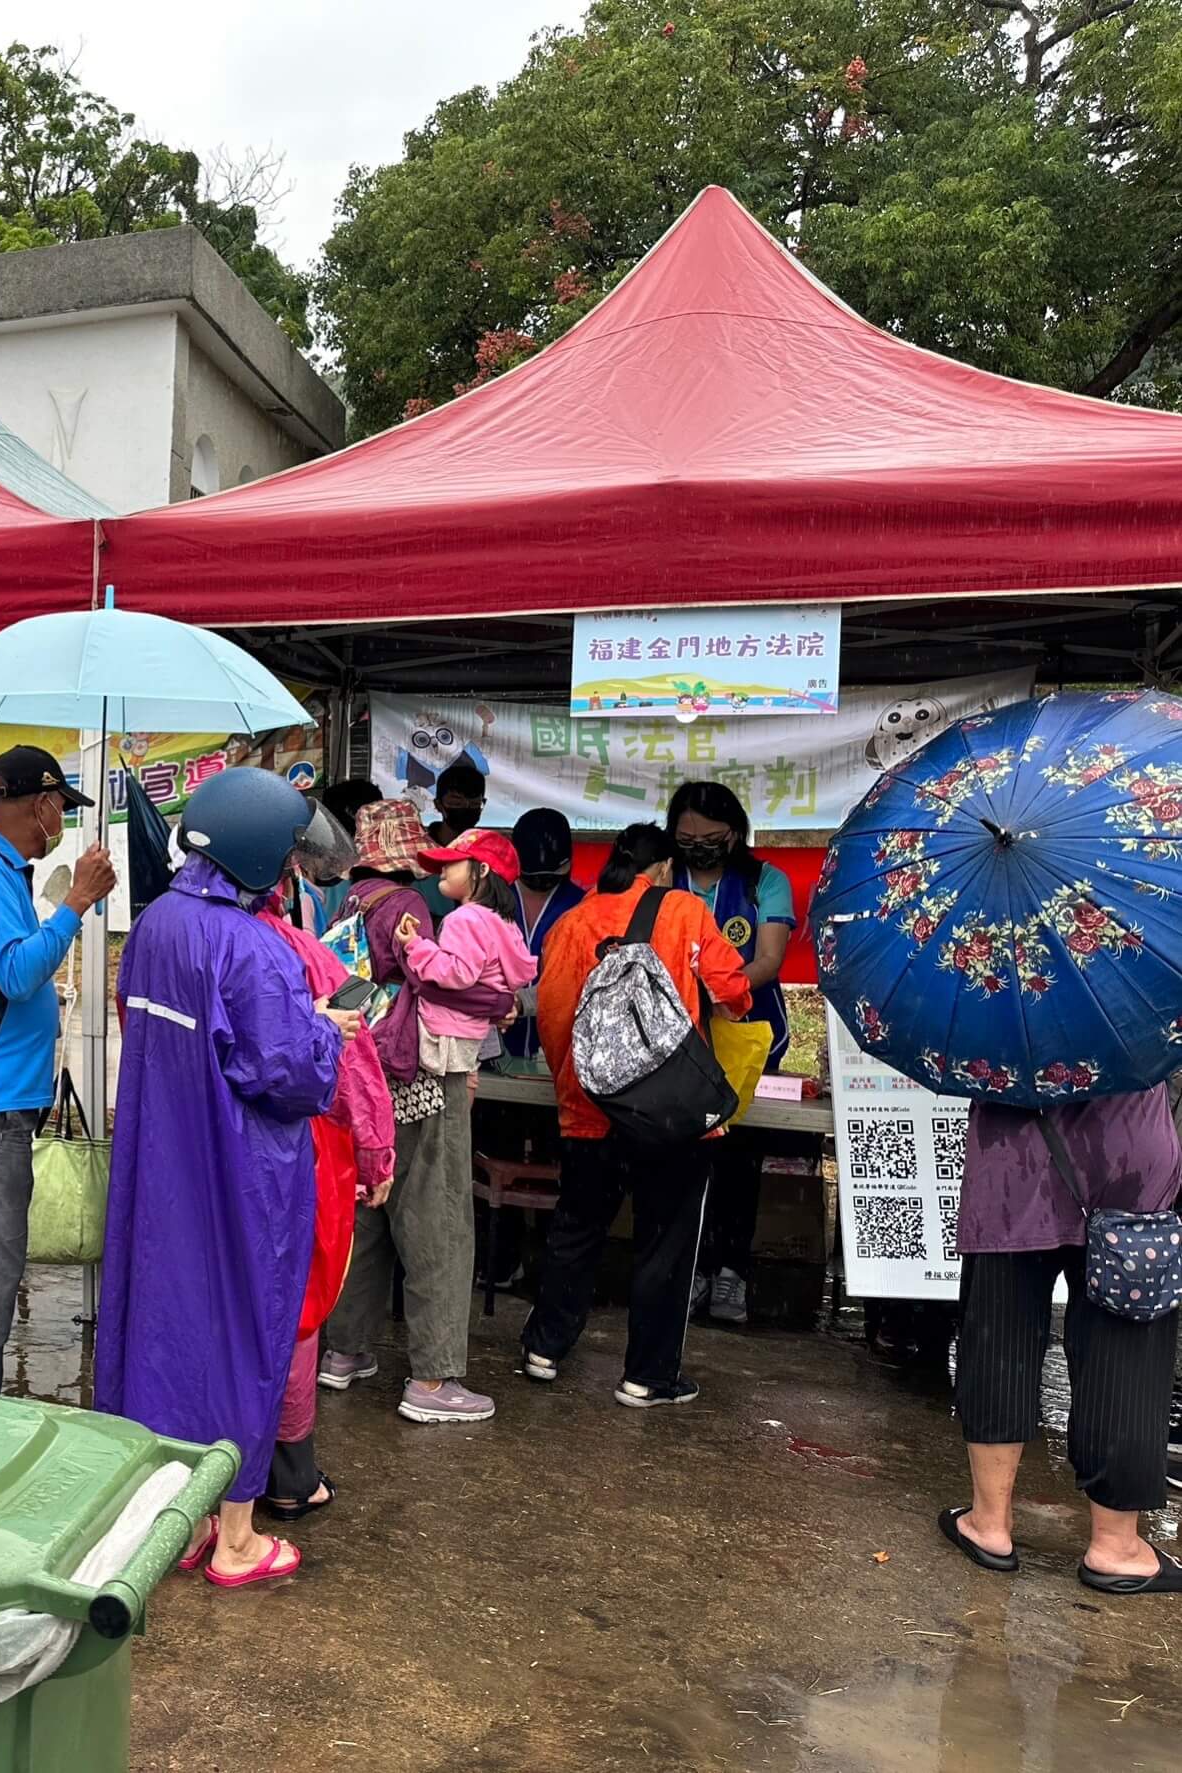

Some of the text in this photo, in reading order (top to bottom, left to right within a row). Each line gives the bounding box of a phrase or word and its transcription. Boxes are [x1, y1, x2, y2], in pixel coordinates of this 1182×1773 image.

[589, 631, 825, 661] 福建金門地方法院
[807, 679, 827, 689] 廣告
[529, 712, 727, 766] 國民法官
[944, 1272, 961, 1281] QRC
